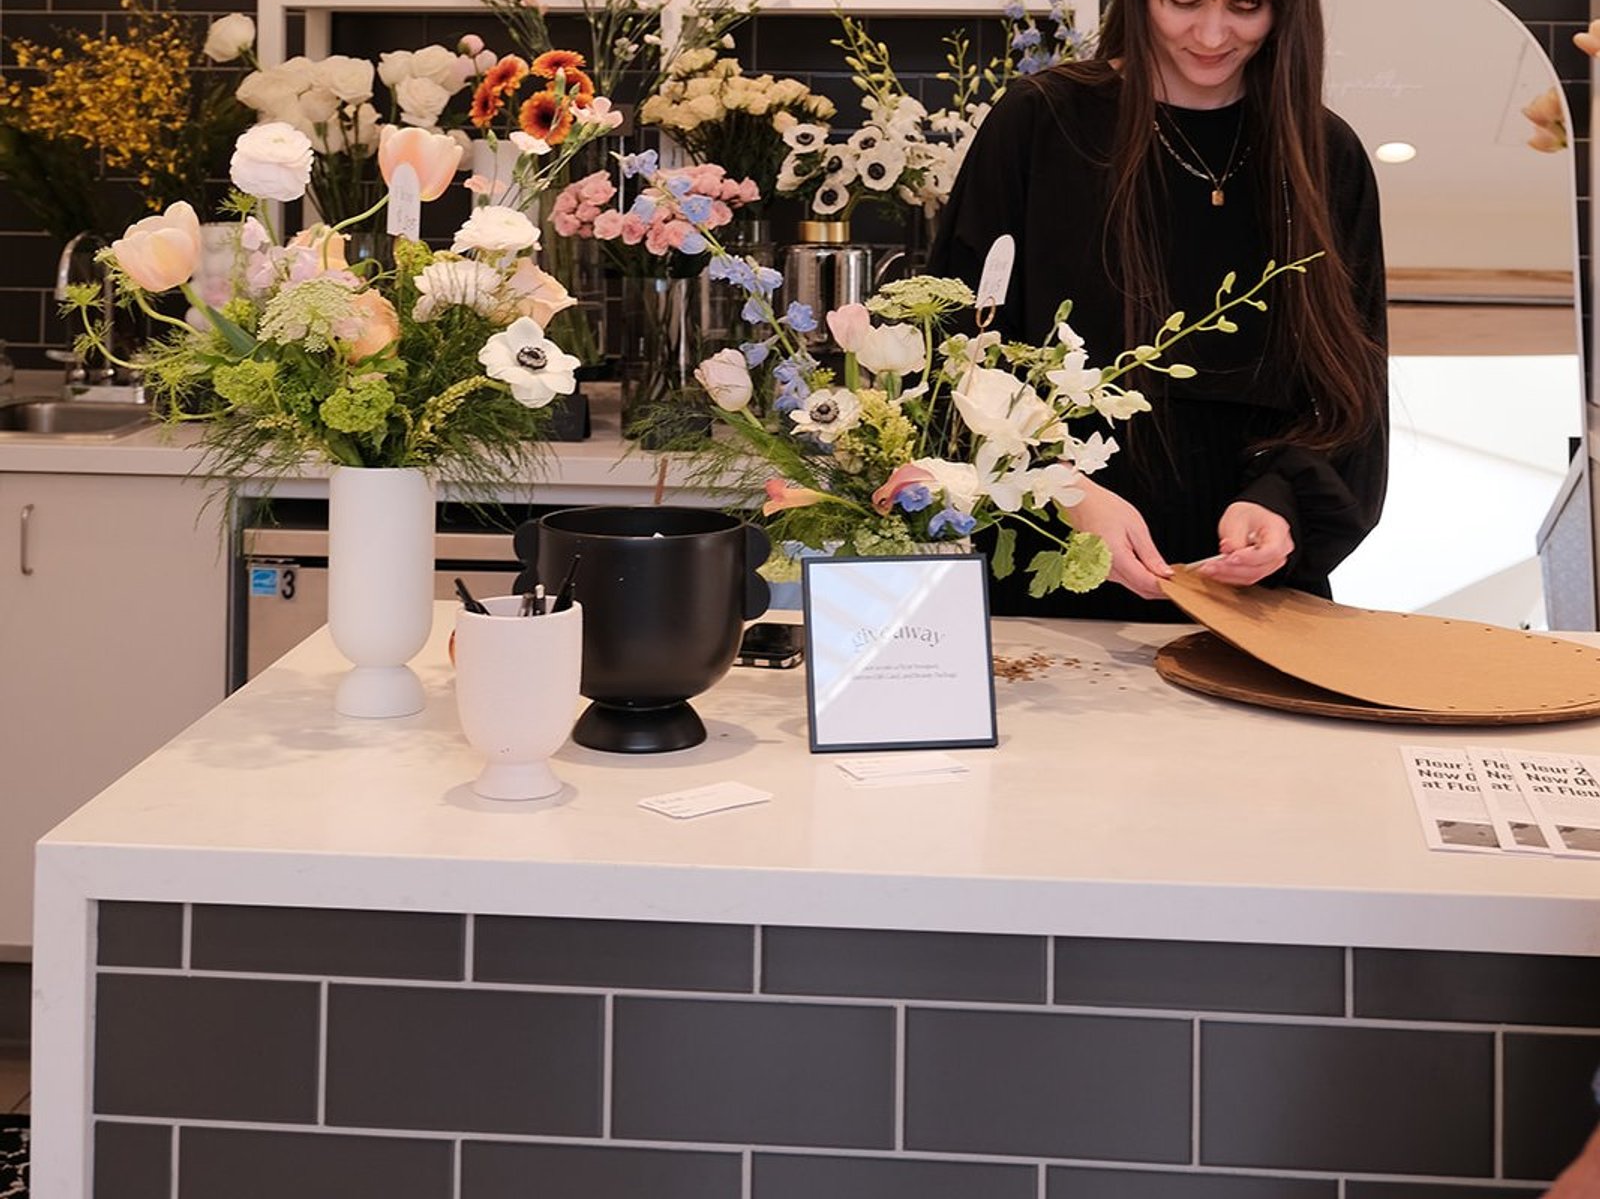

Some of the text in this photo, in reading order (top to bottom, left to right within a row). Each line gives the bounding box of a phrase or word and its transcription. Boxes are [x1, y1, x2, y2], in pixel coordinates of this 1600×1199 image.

[281, 569, 296, 600] 3
[1415, 758, 1463, 770] Fleur
[1481, 759, 1510, 770] Fle
[1520, 762, 1569, 775] Fleur
[1418, 768, 1459, 780] New
[1487, 770, 1512, 781] Ne
[1526, 772, 1568, 784] New
[1421, 781, 1443, 790] at
[1532, 785, 1600, 798] at Fleu
